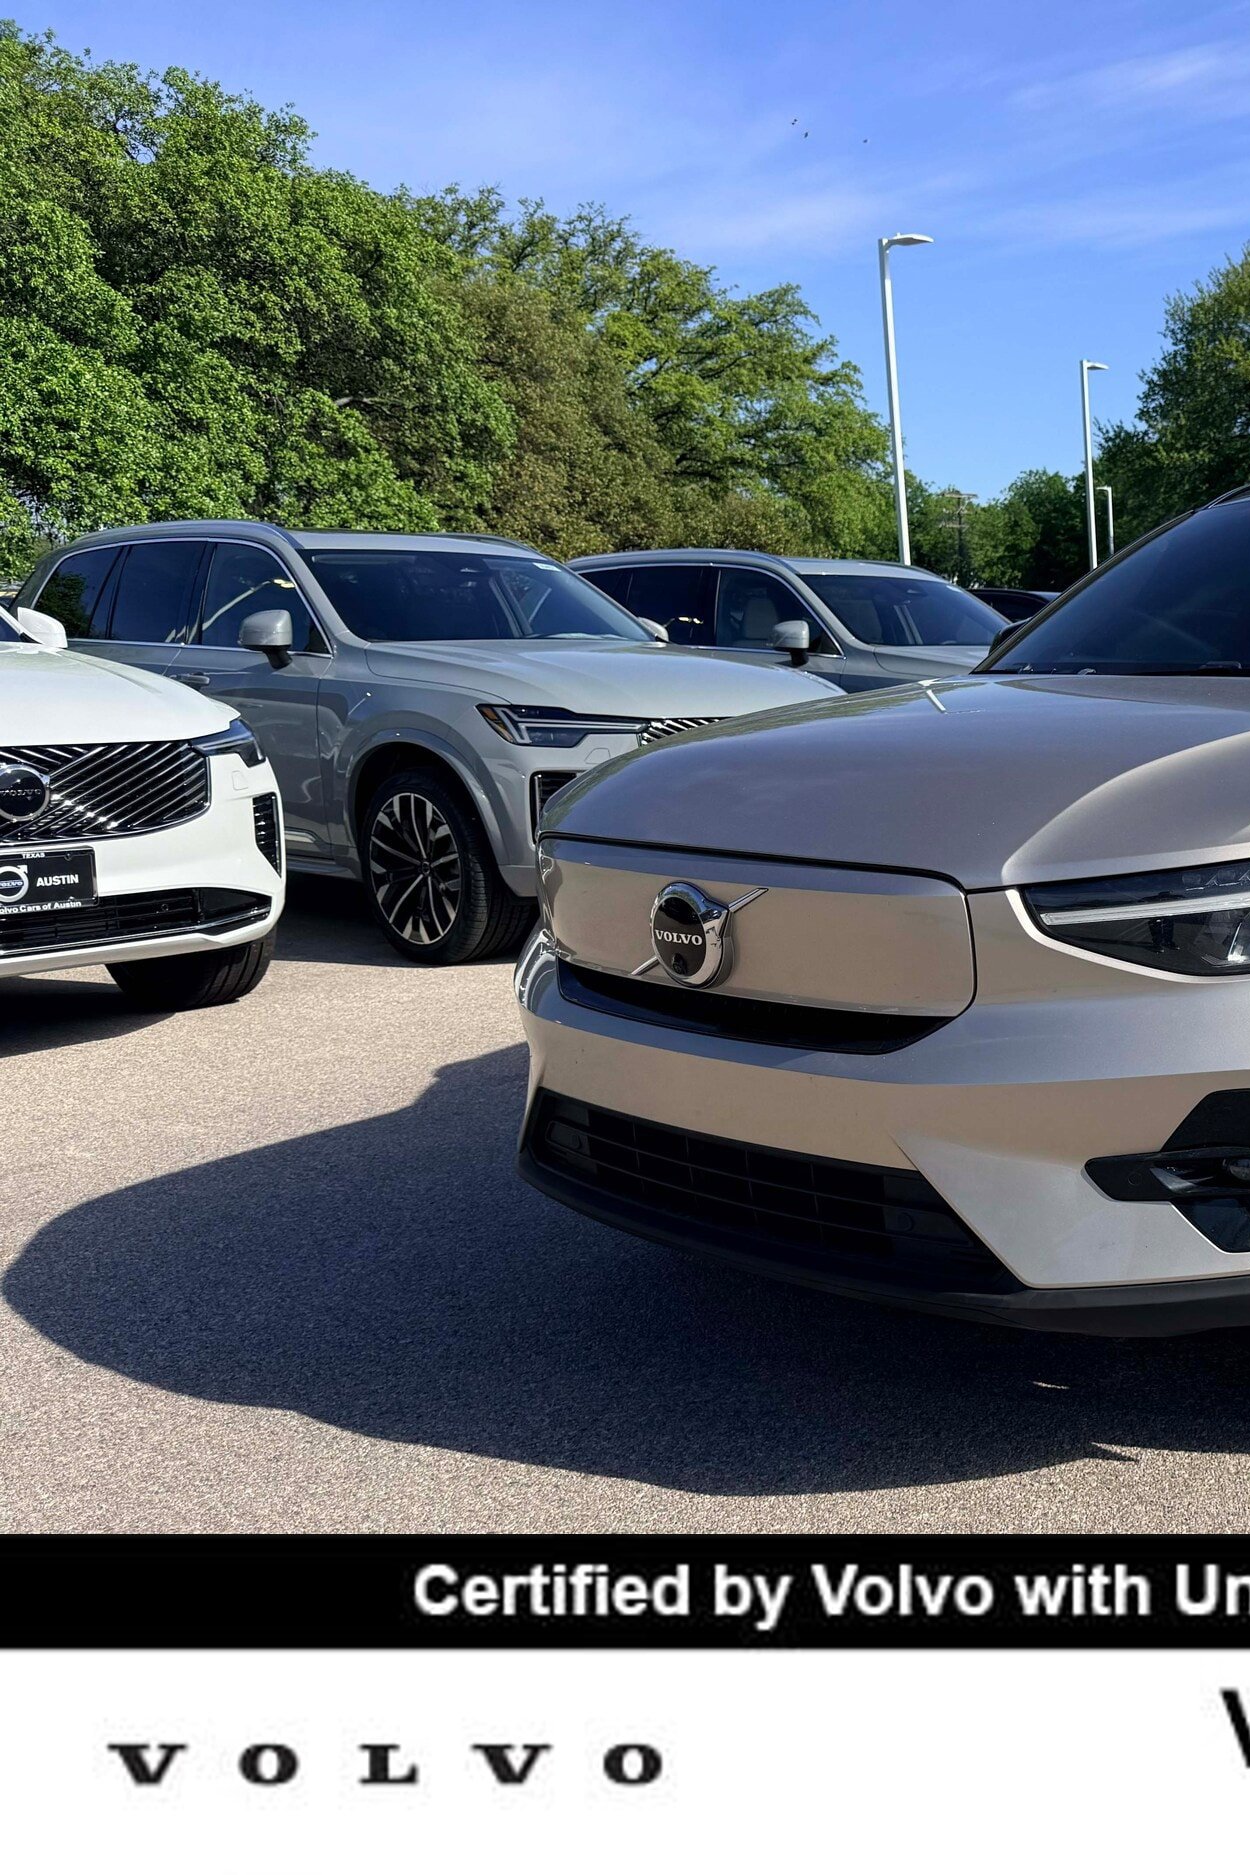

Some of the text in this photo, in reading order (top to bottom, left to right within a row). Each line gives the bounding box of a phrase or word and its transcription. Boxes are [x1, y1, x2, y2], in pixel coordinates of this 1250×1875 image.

[36, 874, 80, 887] AUSTIN
[0, 901, 82, 914] olvo Cars of Austin
[654, 929, 703, 946] VOLVO
